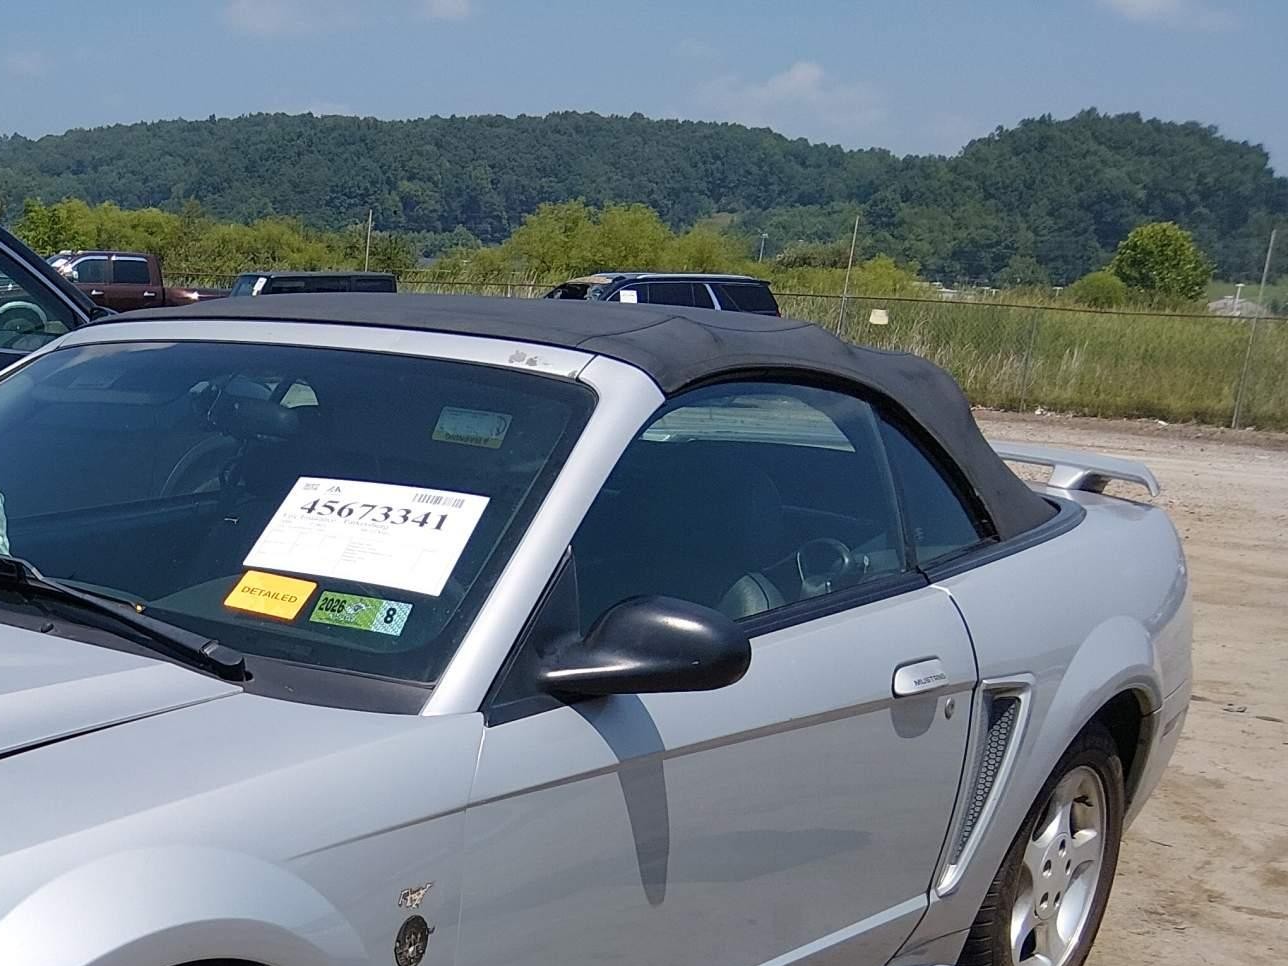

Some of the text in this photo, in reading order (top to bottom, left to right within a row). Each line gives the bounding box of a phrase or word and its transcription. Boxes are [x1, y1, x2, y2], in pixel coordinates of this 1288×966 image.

[300, 498, 449, 530] 45673341
[241, 585, 298, 604] DETAILED
[317, 597, 397, 624] 2026 8
